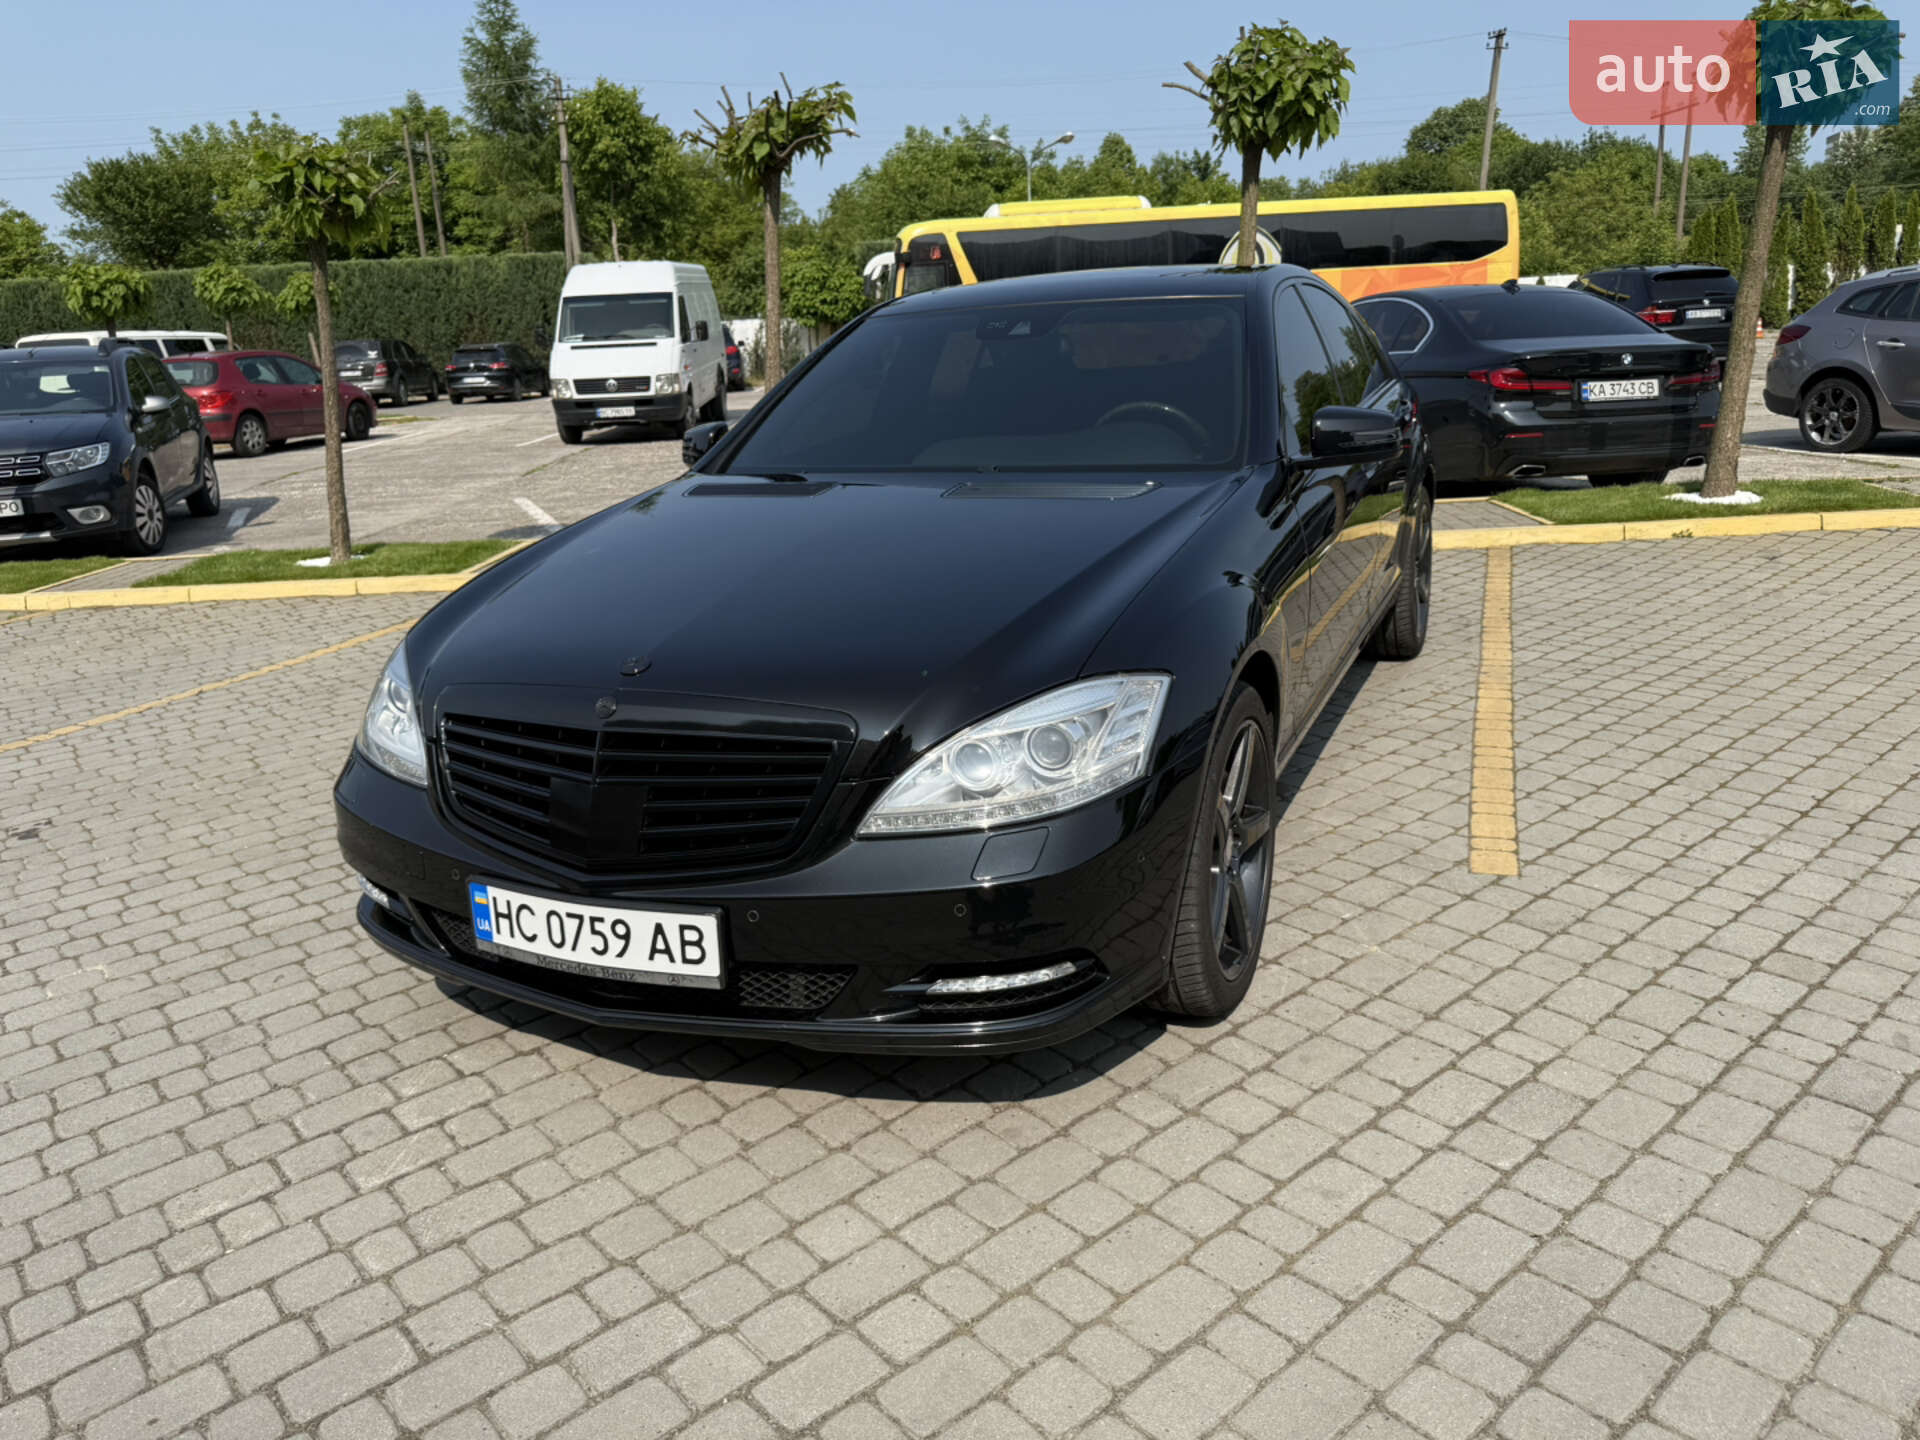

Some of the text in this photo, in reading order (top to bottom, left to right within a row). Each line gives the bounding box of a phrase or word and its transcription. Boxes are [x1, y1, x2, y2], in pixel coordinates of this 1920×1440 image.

[1589, 382, 1655, 396] KA 3743 CB
[476, 917, 491, 931] UA
[492, 896, 706, 965] HC 0759 AB
